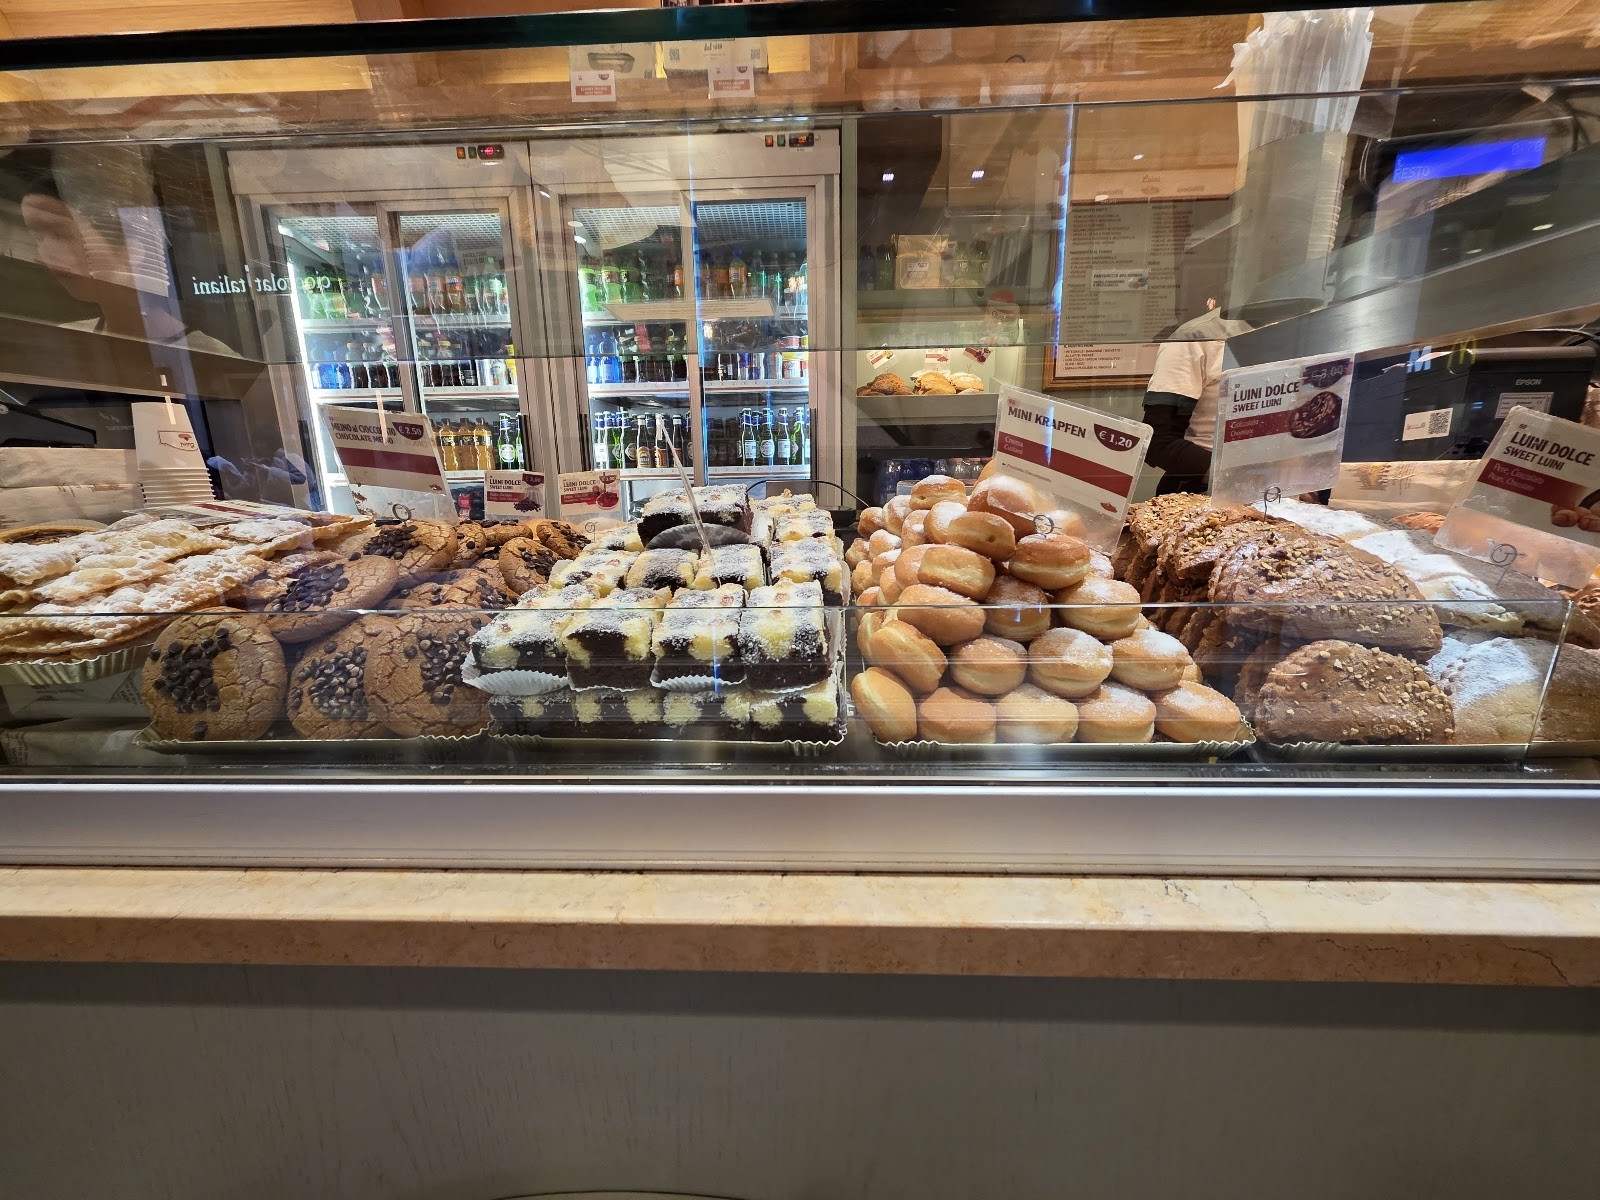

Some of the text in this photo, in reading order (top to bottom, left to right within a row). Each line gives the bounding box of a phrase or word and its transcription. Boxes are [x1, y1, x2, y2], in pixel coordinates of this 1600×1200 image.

[1394, 165, 1430, 179] RESTO
[1515, 378, 1542, 386] EPSON
[1233, 381, 1300, 403] LUINI DOLCE
[1232, 397, 1282, 413] SWEET LUINI
[1008, 406, 1087, 438] MINI KRAPFEN
[335, 432, 372, 442] CHOCOLATE
[1004, 435, 1024, 447] Crema
[1109, 431, 1134, 449] 1,20
[1510, 431, 1596, 466] LUINI DOLCE
[1503, 446, 1565, 471] SWEET LUINI
